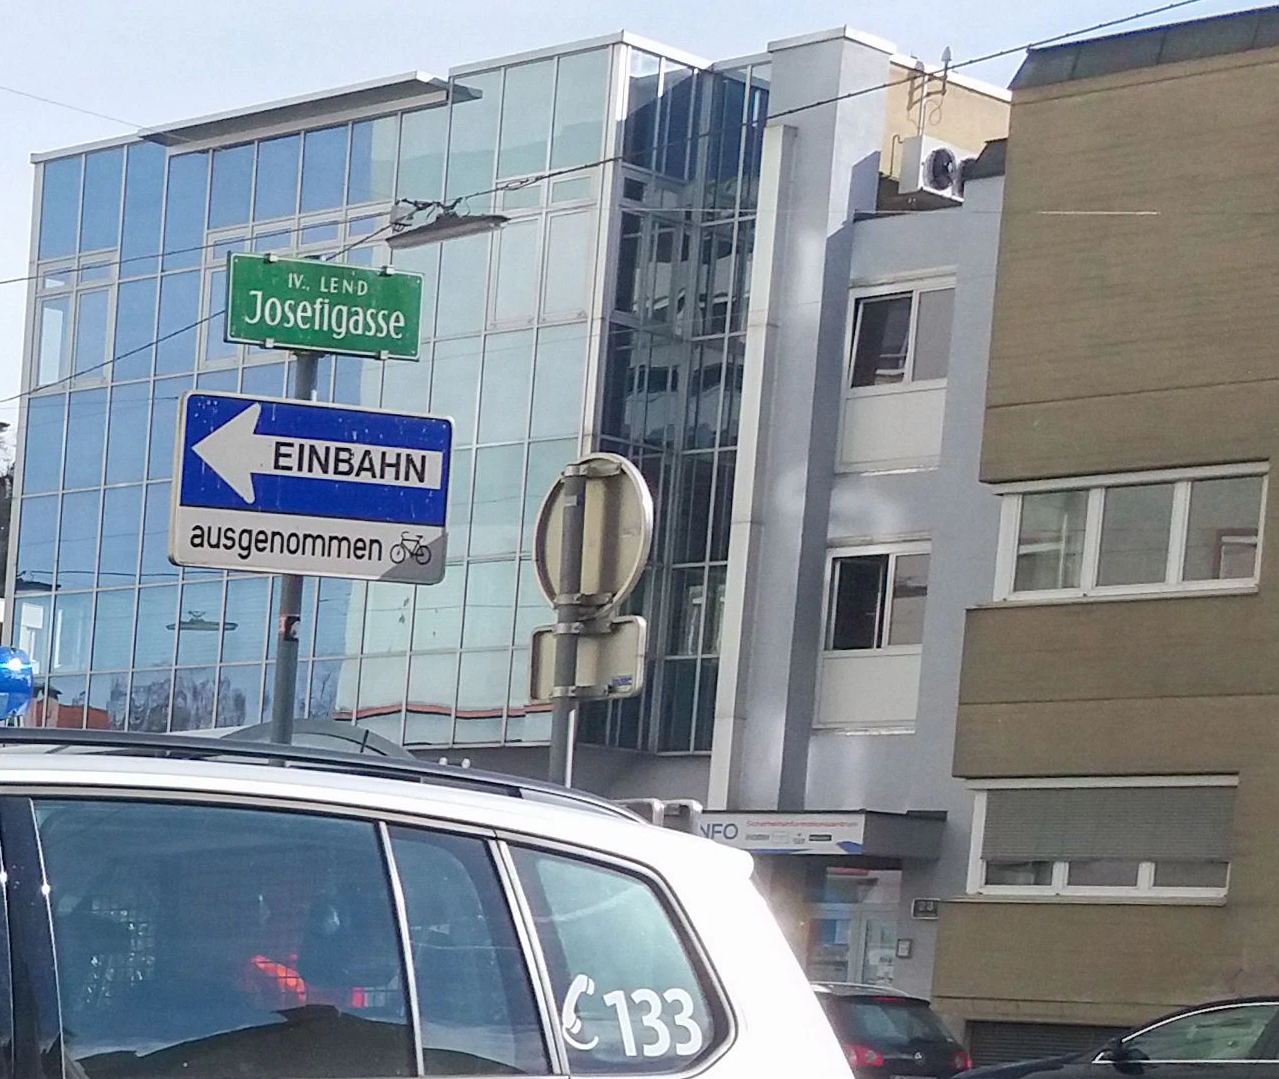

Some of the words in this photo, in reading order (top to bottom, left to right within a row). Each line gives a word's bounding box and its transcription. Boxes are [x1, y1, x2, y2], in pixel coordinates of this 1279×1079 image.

[320, 277, 368, 296] LEND
[244, 290, 406, 340] Josefigasse
[273, 441, 427, 483] EINBAHN
[190, 524, 384, 562] ausgenommen
[603, 988, 703, 1057] 133
